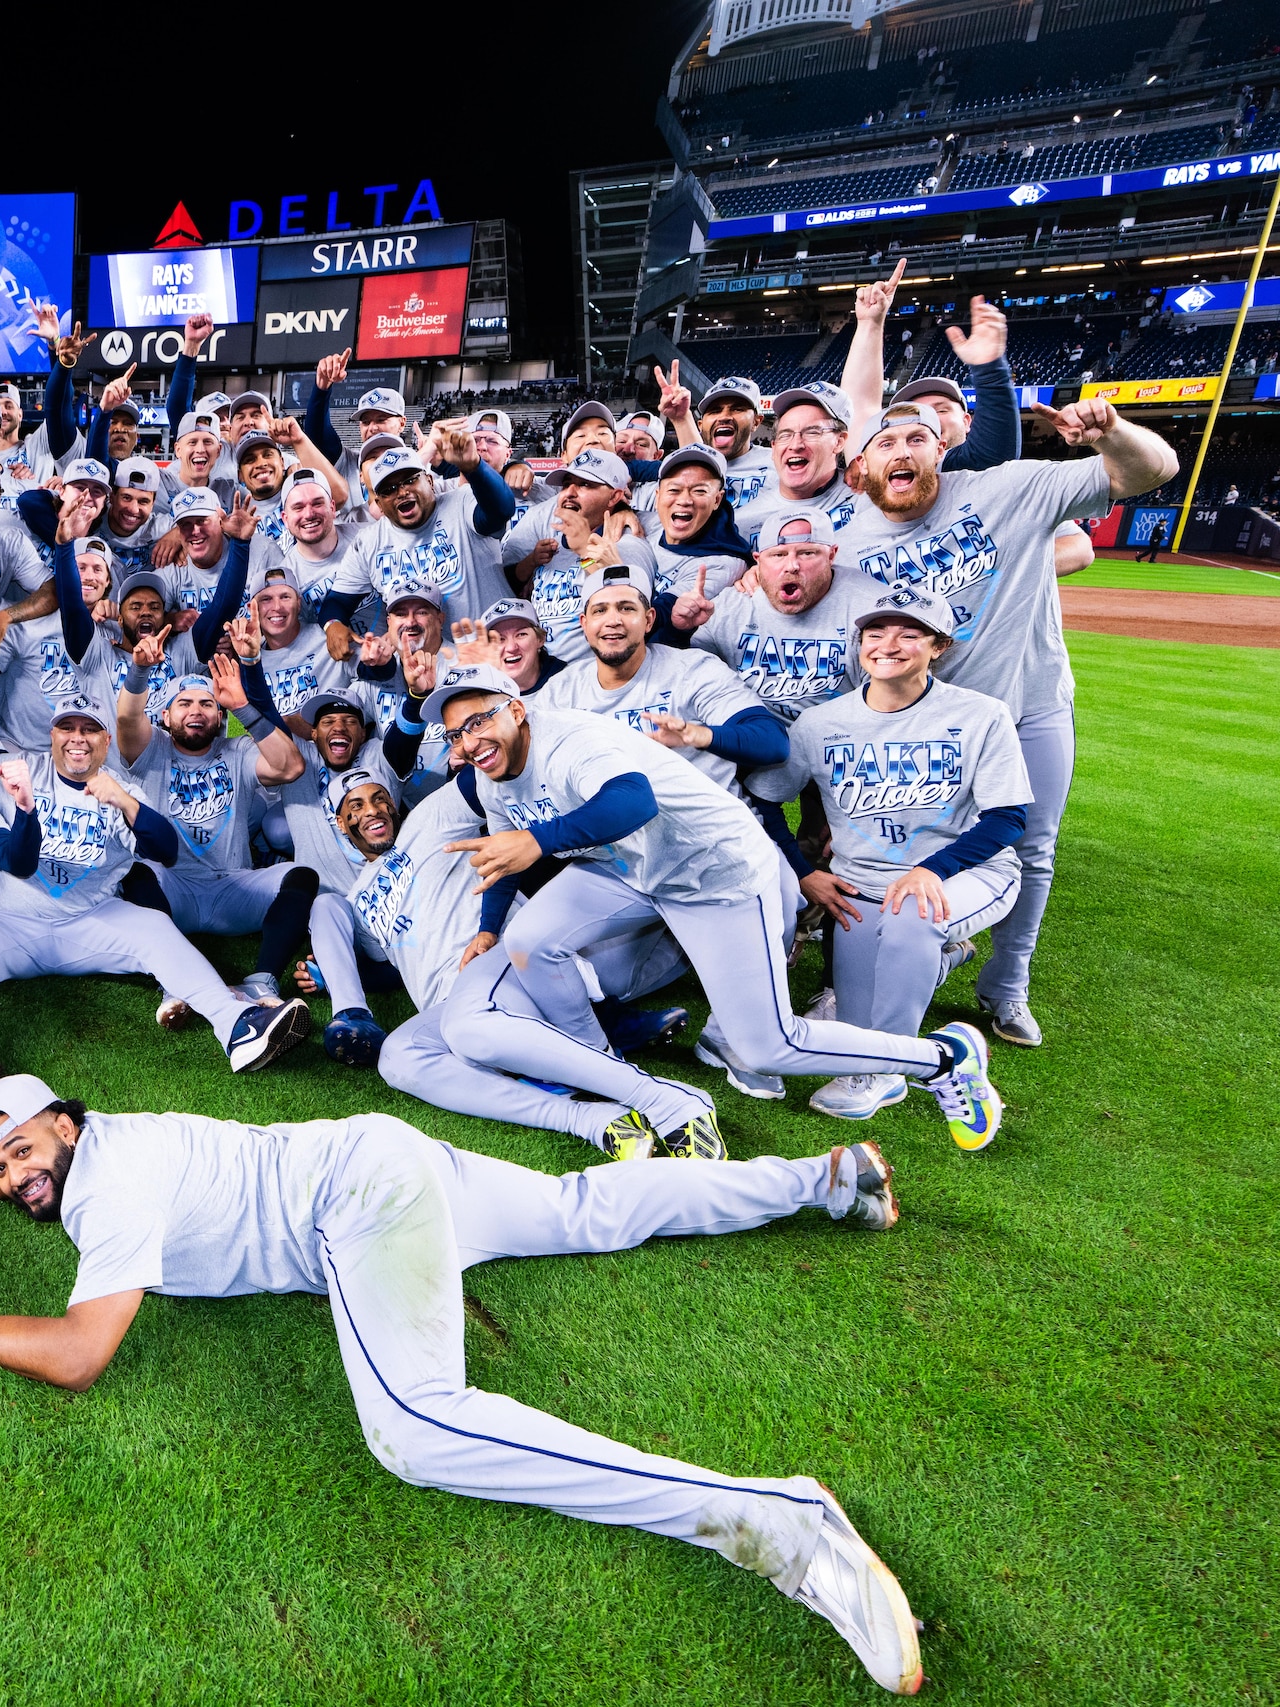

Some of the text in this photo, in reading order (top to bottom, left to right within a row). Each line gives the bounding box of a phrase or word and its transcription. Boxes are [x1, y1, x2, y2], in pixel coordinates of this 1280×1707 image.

[1162, 163, 1211, 186] RAYS
[228, 179, 443, 241] DELTA
[824, 209, 855, 223] ALDS
[310, 235, 417, 274] STARR
[152, 263, 194, 287] RAYS
[708, 278, 765, 291] 2021 MLS CUP
[136, 292, 207, 316] YANKEES
[264, 308, 349, 335] DKNY
[373, 328, 400, 339] Made
[408, 326, 444, 337] America
[376, 313, 447, 329] Budweiser
[333, 398, 351, 406] THE
[529, 461, 558, 469] eebok
[1141, 513, 1170, 523] NEW
[1195, 510, 1218, 521] 314
[375, 529, 457, 586] TAKE
[859, 514, 997, 587] TAKE
[737, 632, 846, 679] TAKE
[741, 666, 844, 700] October
[824, 741, 963, 787] TAKE
[170, 760, 234, 804] TAKE
[834, 771, 961, 815] October
[189, 825, 210, 845] TB
[874, 817, 908, 844] TB
[45, 859, 69, 885] TB
[392, 914, 413, 936] TB
